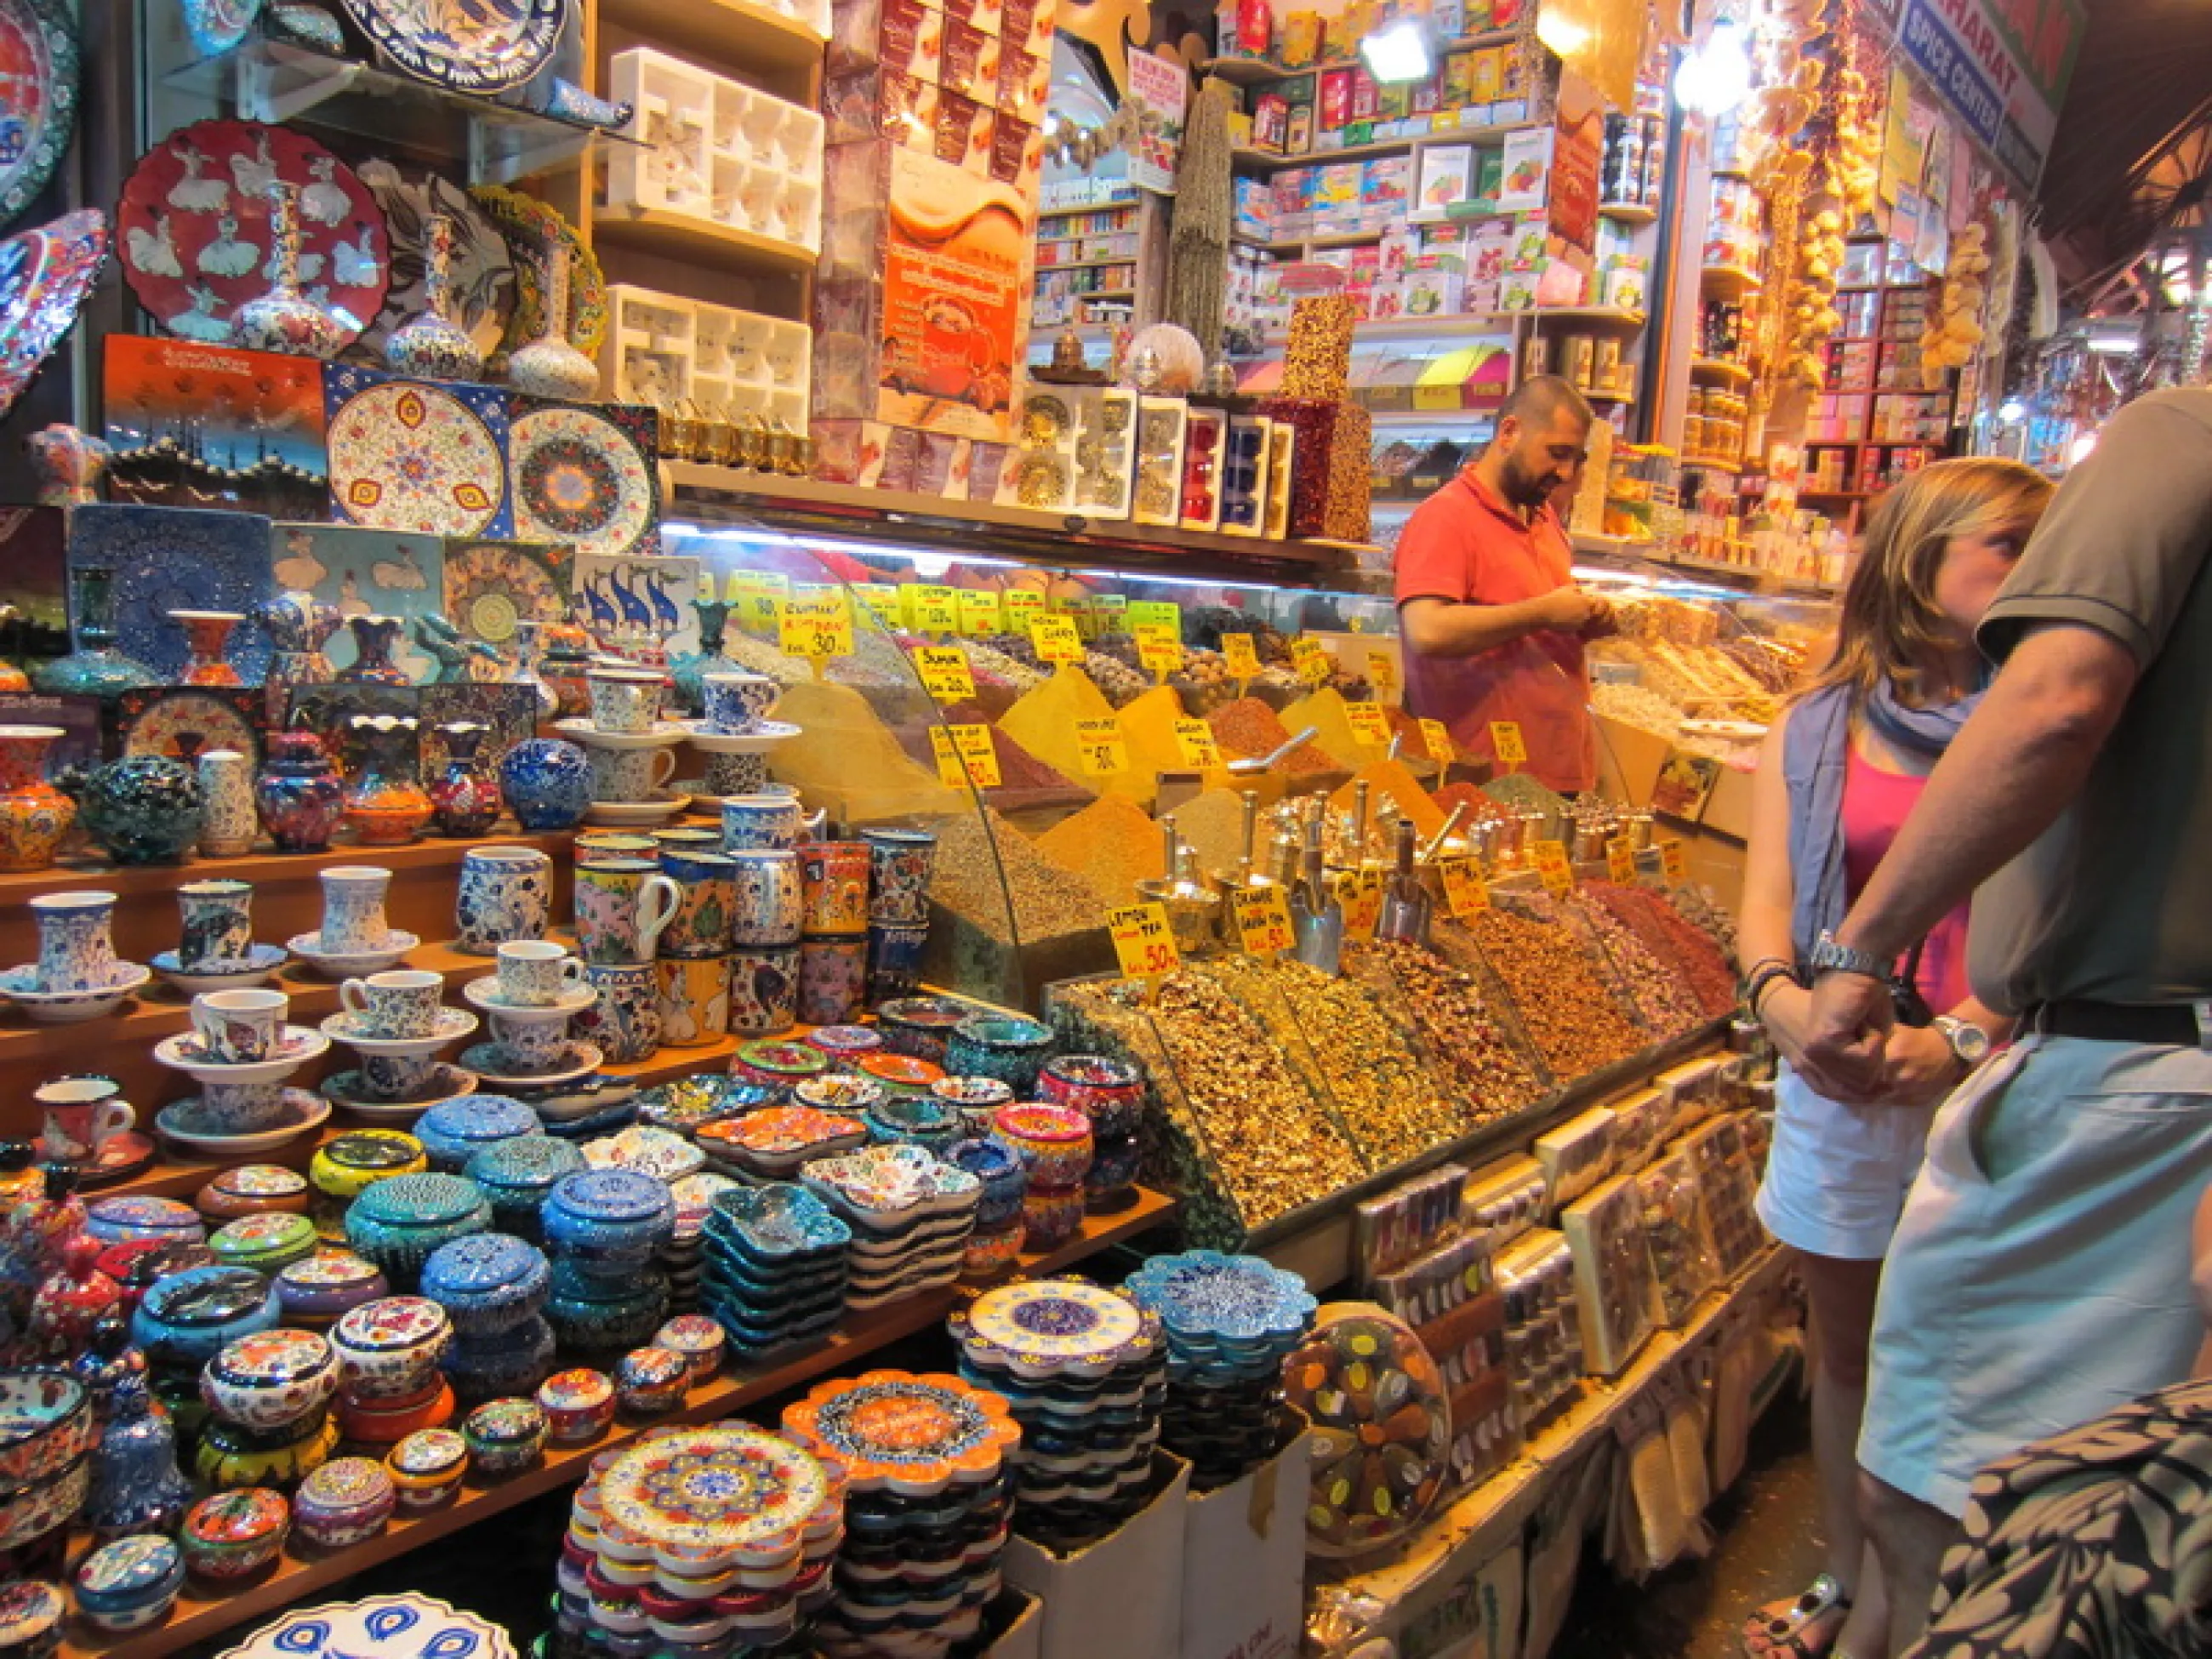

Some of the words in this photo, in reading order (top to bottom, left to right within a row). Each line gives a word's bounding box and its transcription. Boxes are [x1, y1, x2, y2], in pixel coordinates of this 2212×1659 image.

[1907, 8, 1953, 80] SPICE
[1951, 62, 1997, 129] CENTER
[1938, 0, 2019, 96] HARAT
[812, 633, 836, 656] 30
[1145, 943, 1168, 973] 50
